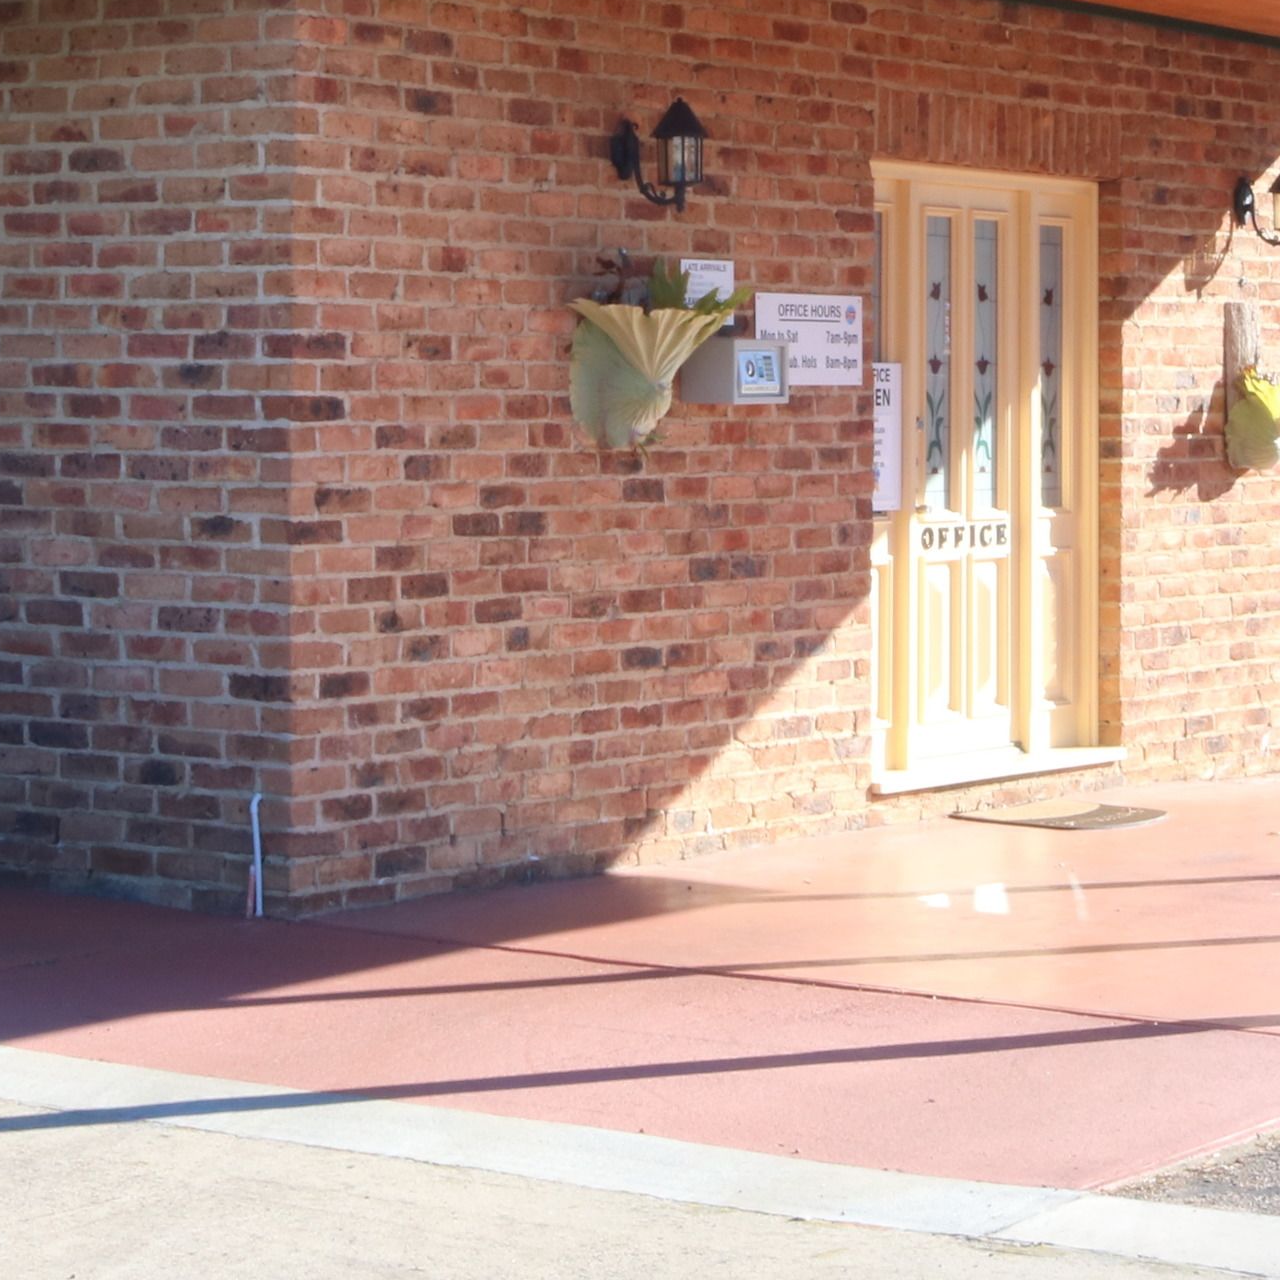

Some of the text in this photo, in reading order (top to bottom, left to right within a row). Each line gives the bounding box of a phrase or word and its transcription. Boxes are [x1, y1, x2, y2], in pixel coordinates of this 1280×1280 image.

[777, 303, 809, 317] OFFICE
[810, 305, 841, 319] HOURS
[760, 329, 858, 346] Mon to Sat 7am-9pm
[789, 355, 800, 369] ub.
[801, 355, 817, 369] Hols
[875, 388, 891, 406] EN
[920, 524, 1007, 550] OFFICE
